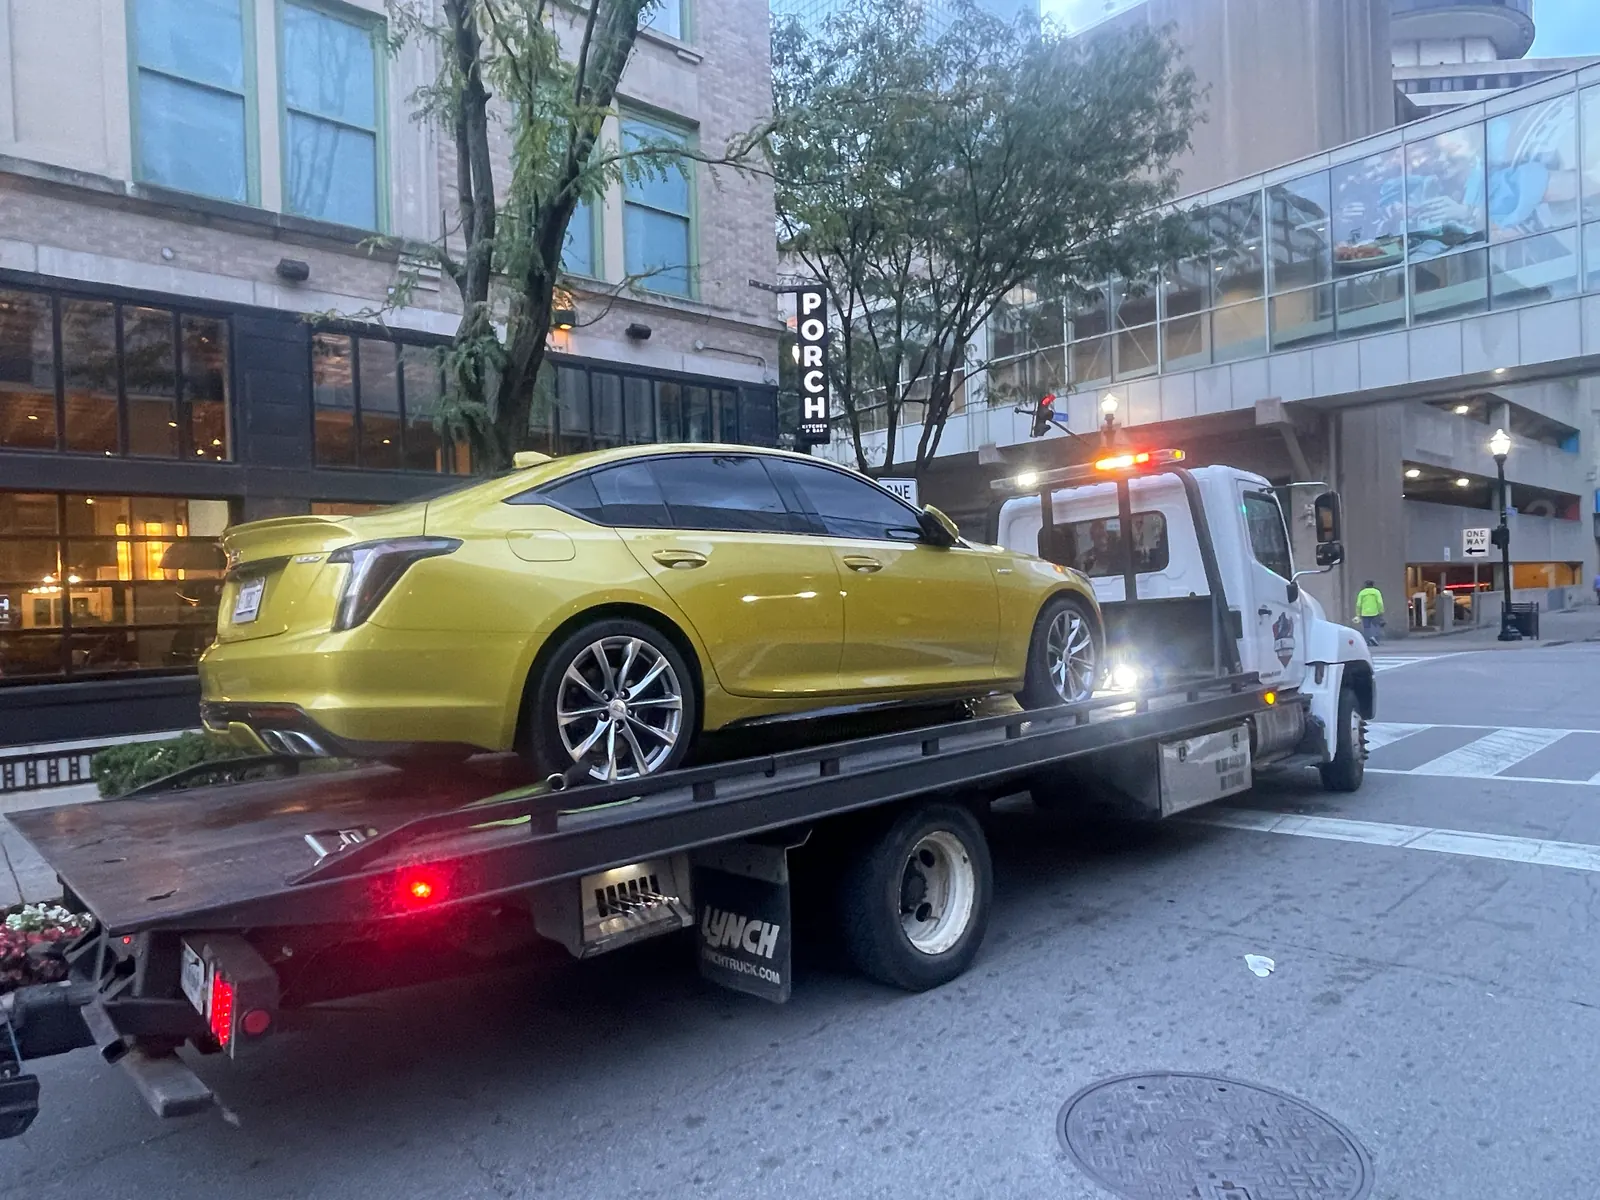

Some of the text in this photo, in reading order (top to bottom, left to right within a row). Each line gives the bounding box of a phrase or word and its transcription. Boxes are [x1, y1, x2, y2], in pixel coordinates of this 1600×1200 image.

[801, 292, 825, 419] PORCH
[886, 484, 911, 499] NE
[1466, 530, 1485, 538] ONE
[701, 905, 780, 959] LYNCH
